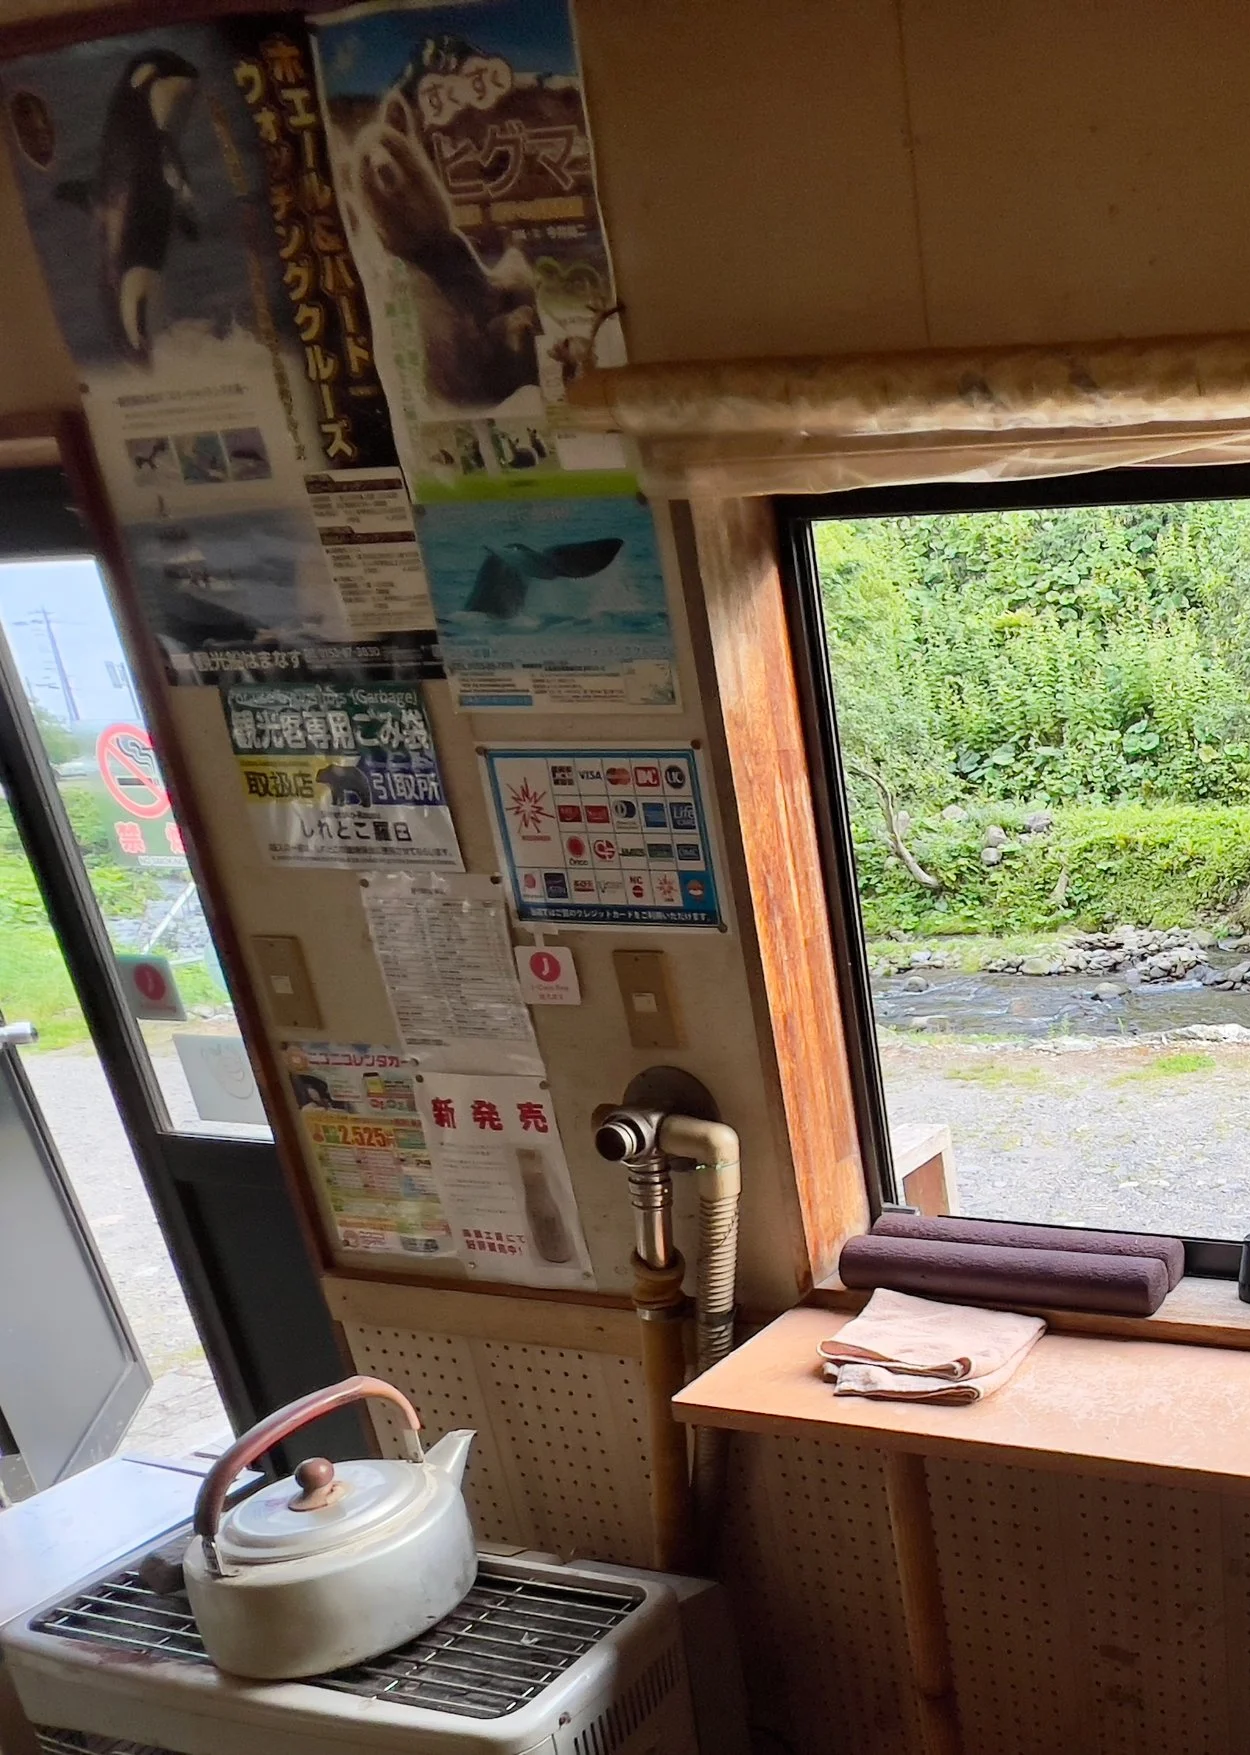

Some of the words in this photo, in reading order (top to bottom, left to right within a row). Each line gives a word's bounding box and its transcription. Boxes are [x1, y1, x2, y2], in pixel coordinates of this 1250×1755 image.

[431, 119, 579, 200] ヒグマ
[352, 688, 417, 708] (Garbage)
[231, 709, 430, 750] 観光客専用ごみ袋
[245, 771, 314, 798] 取扱店
[370, 772, 441, 801] 引取所
[579, 770, 602, 780] VISA
[667, 771, 684, 783] UC
[673, 804, 696, 819] Life
[308, 1052, 409, 1068] ニコニコレンタカー
[431, 1096, 549, 1134] 新発売
